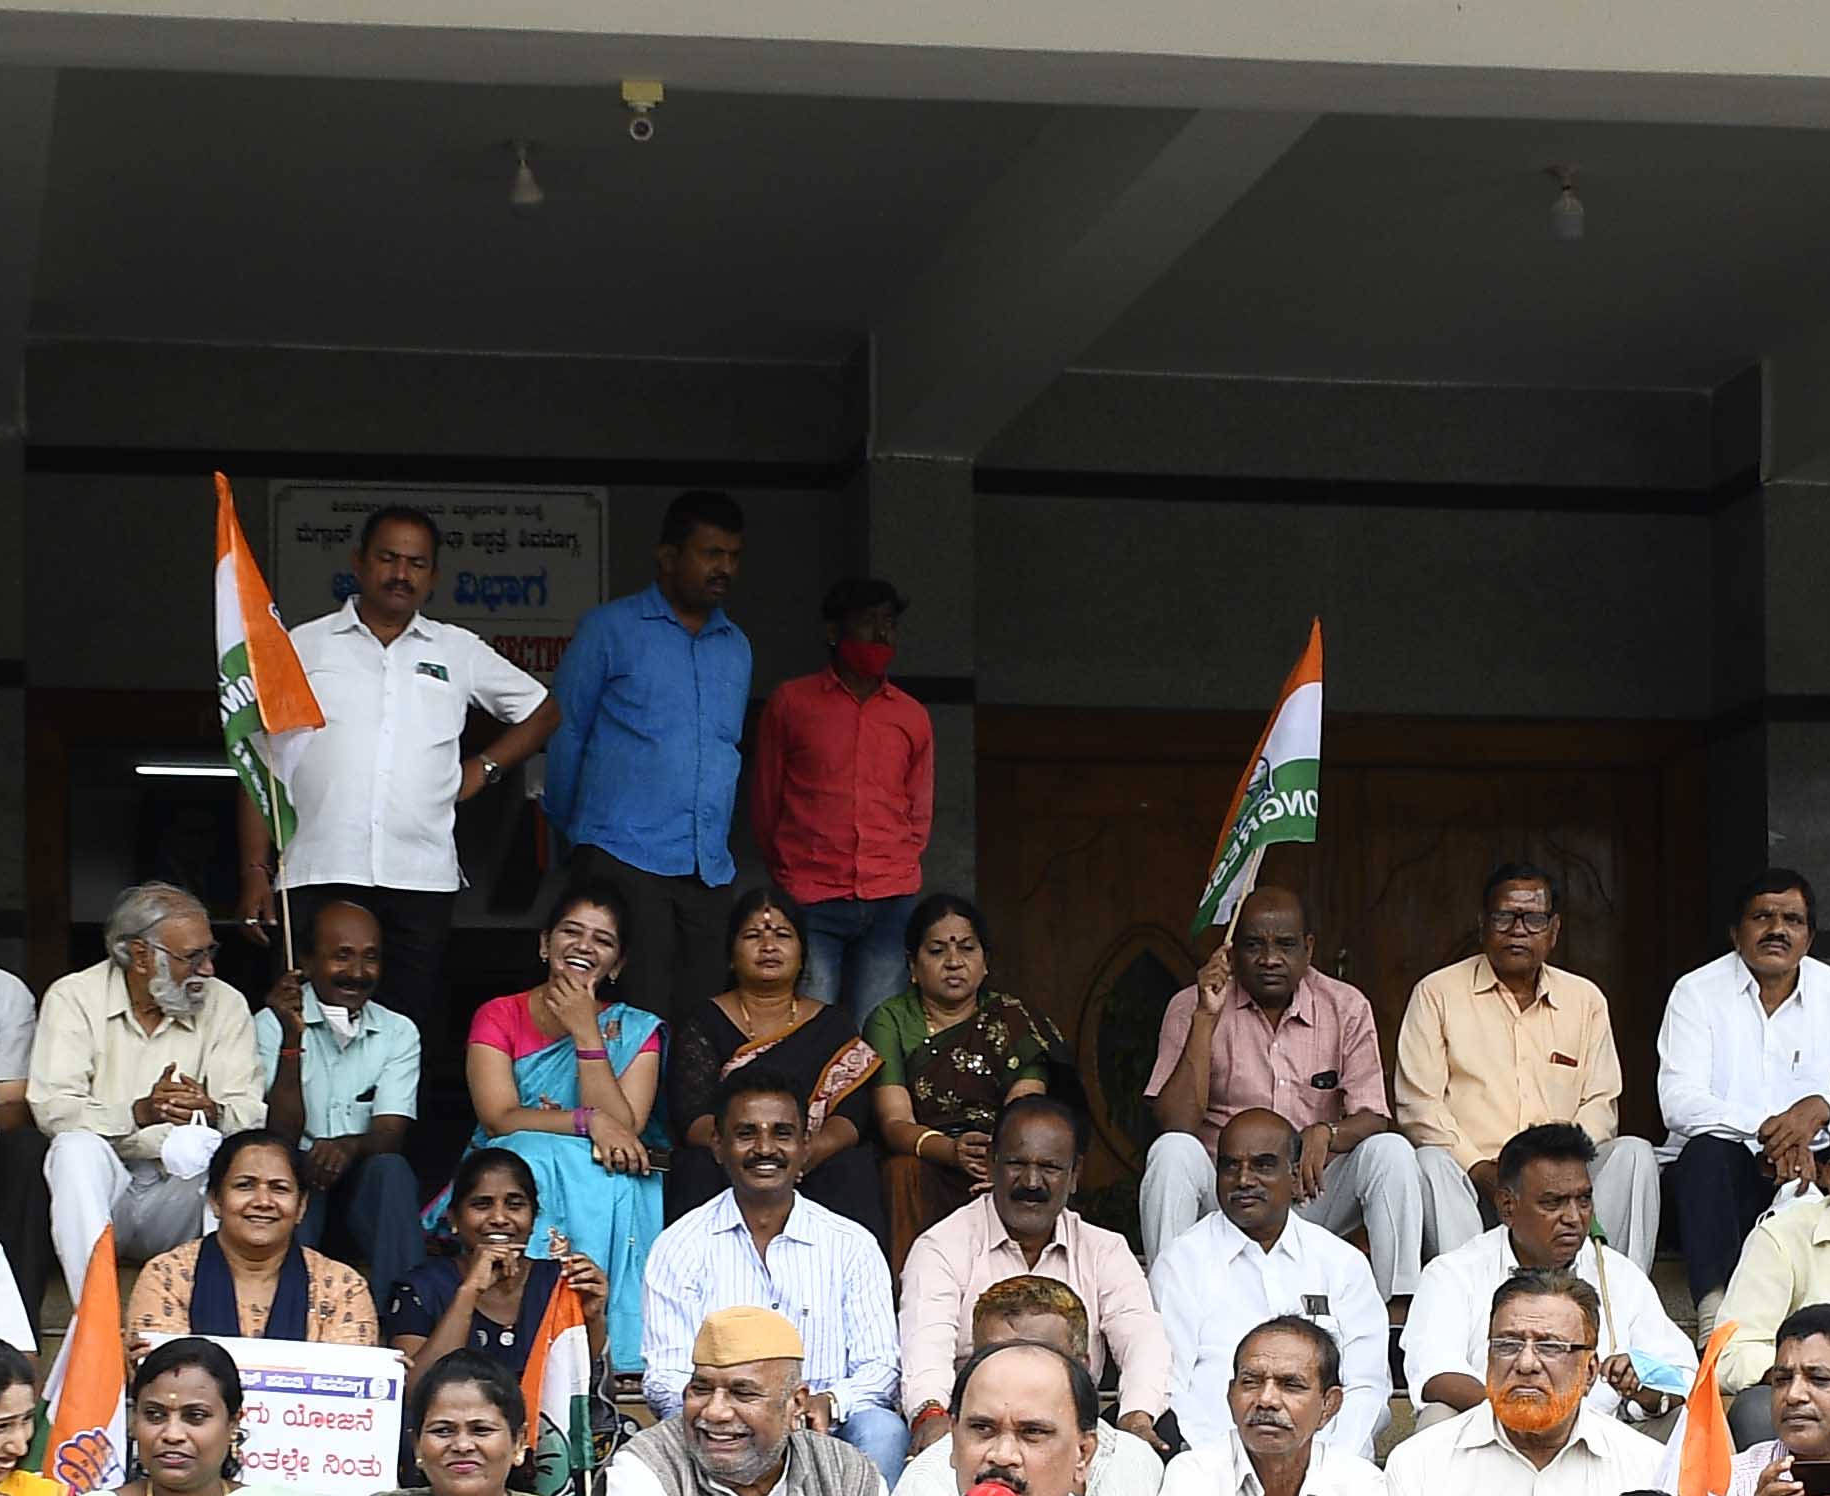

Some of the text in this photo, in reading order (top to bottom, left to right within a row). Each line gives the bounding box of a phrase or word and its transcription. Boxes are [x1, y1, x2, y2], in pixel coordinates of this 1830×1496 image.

[454, 566, 548, 612] ವಿಭಾಗ
[282, 1404, 375, 1431] ಯೋಜನೆ
[322, 1453, 383, 1478] ನಿಂತು
